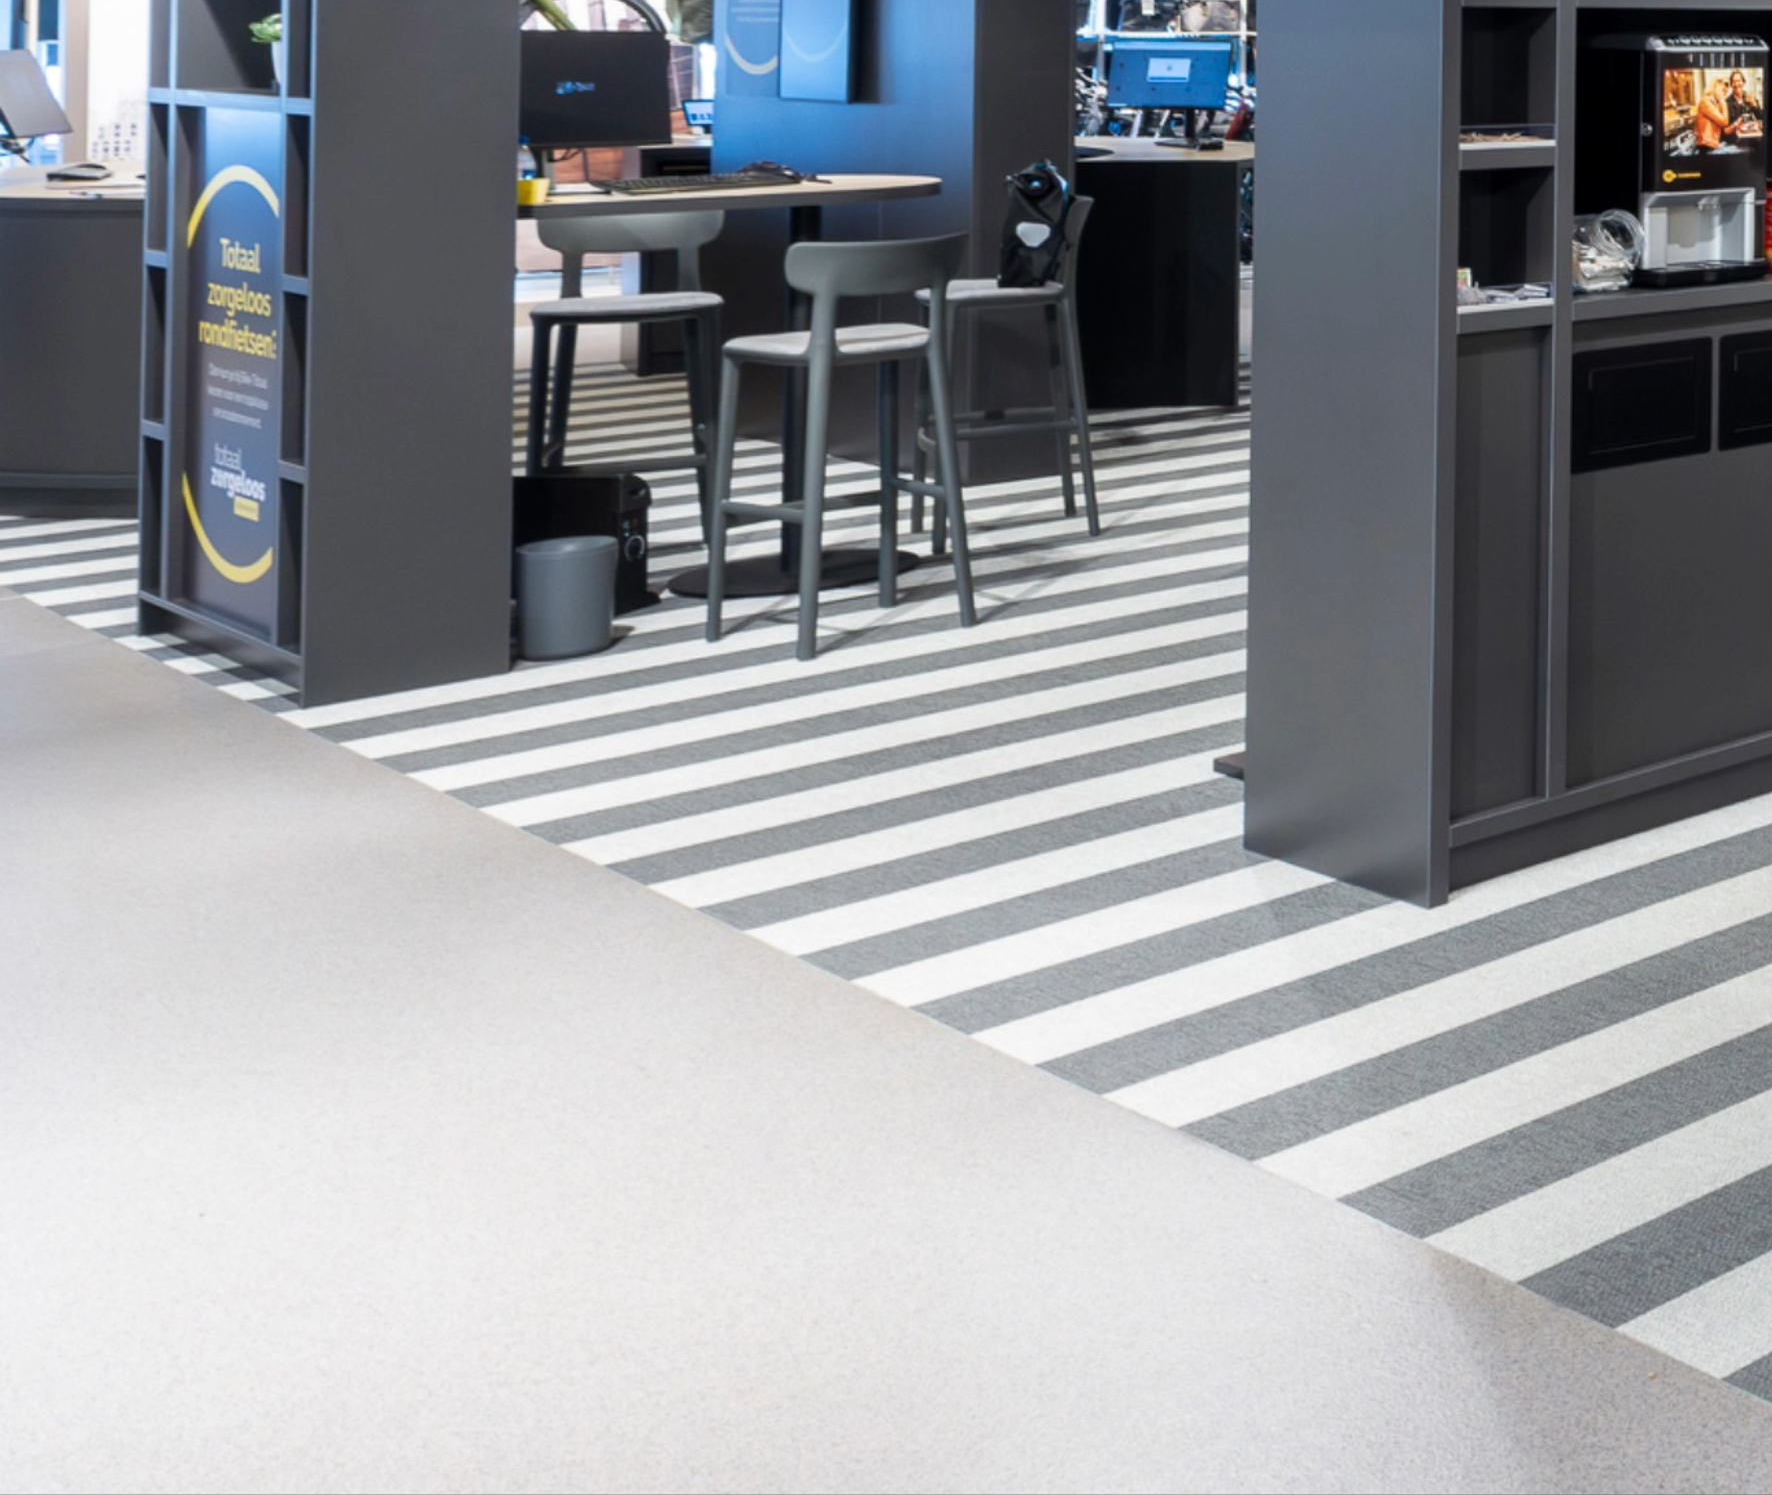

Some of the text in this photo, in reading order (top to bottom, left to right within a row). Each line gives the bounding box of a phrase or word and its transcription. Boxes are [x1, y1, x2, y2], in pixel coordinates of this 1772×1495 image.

[219, 237, 261, 274] Totaal
[207, 282, 272, 317] zorgeloos
[210, 466, 267, 502] zorgeloos
